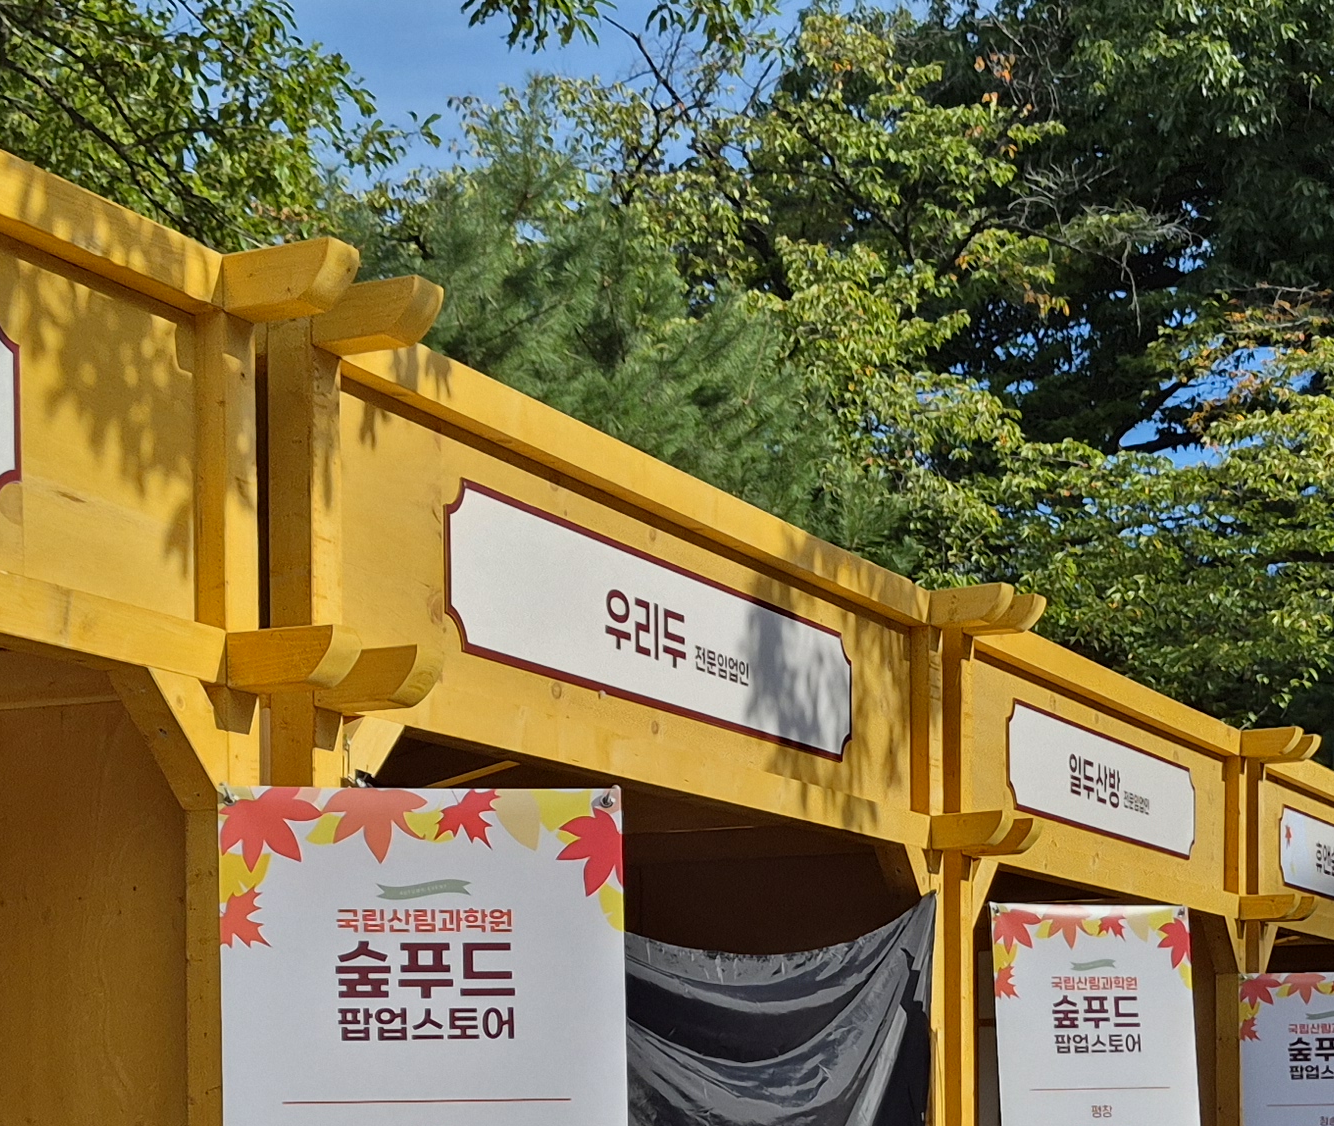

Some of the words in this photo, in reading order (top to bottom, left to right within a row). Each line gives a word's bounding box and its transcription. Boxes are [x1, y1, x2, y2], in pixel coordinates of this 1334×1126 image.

[605, 589, 686, 669] 우리두
[695, 645, 749, 687] 전문임업인
[1069, 753, 1121, 809] 일두산방
[336, 908, 513, 933] 국립산림과학원
[334, 940, 516, 999] 숲푸드
[1051, 976, 1138, 991] 국립산림과학원
[337, 1007, 515, 1042] 팝업스토어
[1052, 995, 1141, 1029] 숲푸드
[1054, 1033, 1142, 1054] 팝업스토어
[1091, 1105, 1113, 1118] 평창
